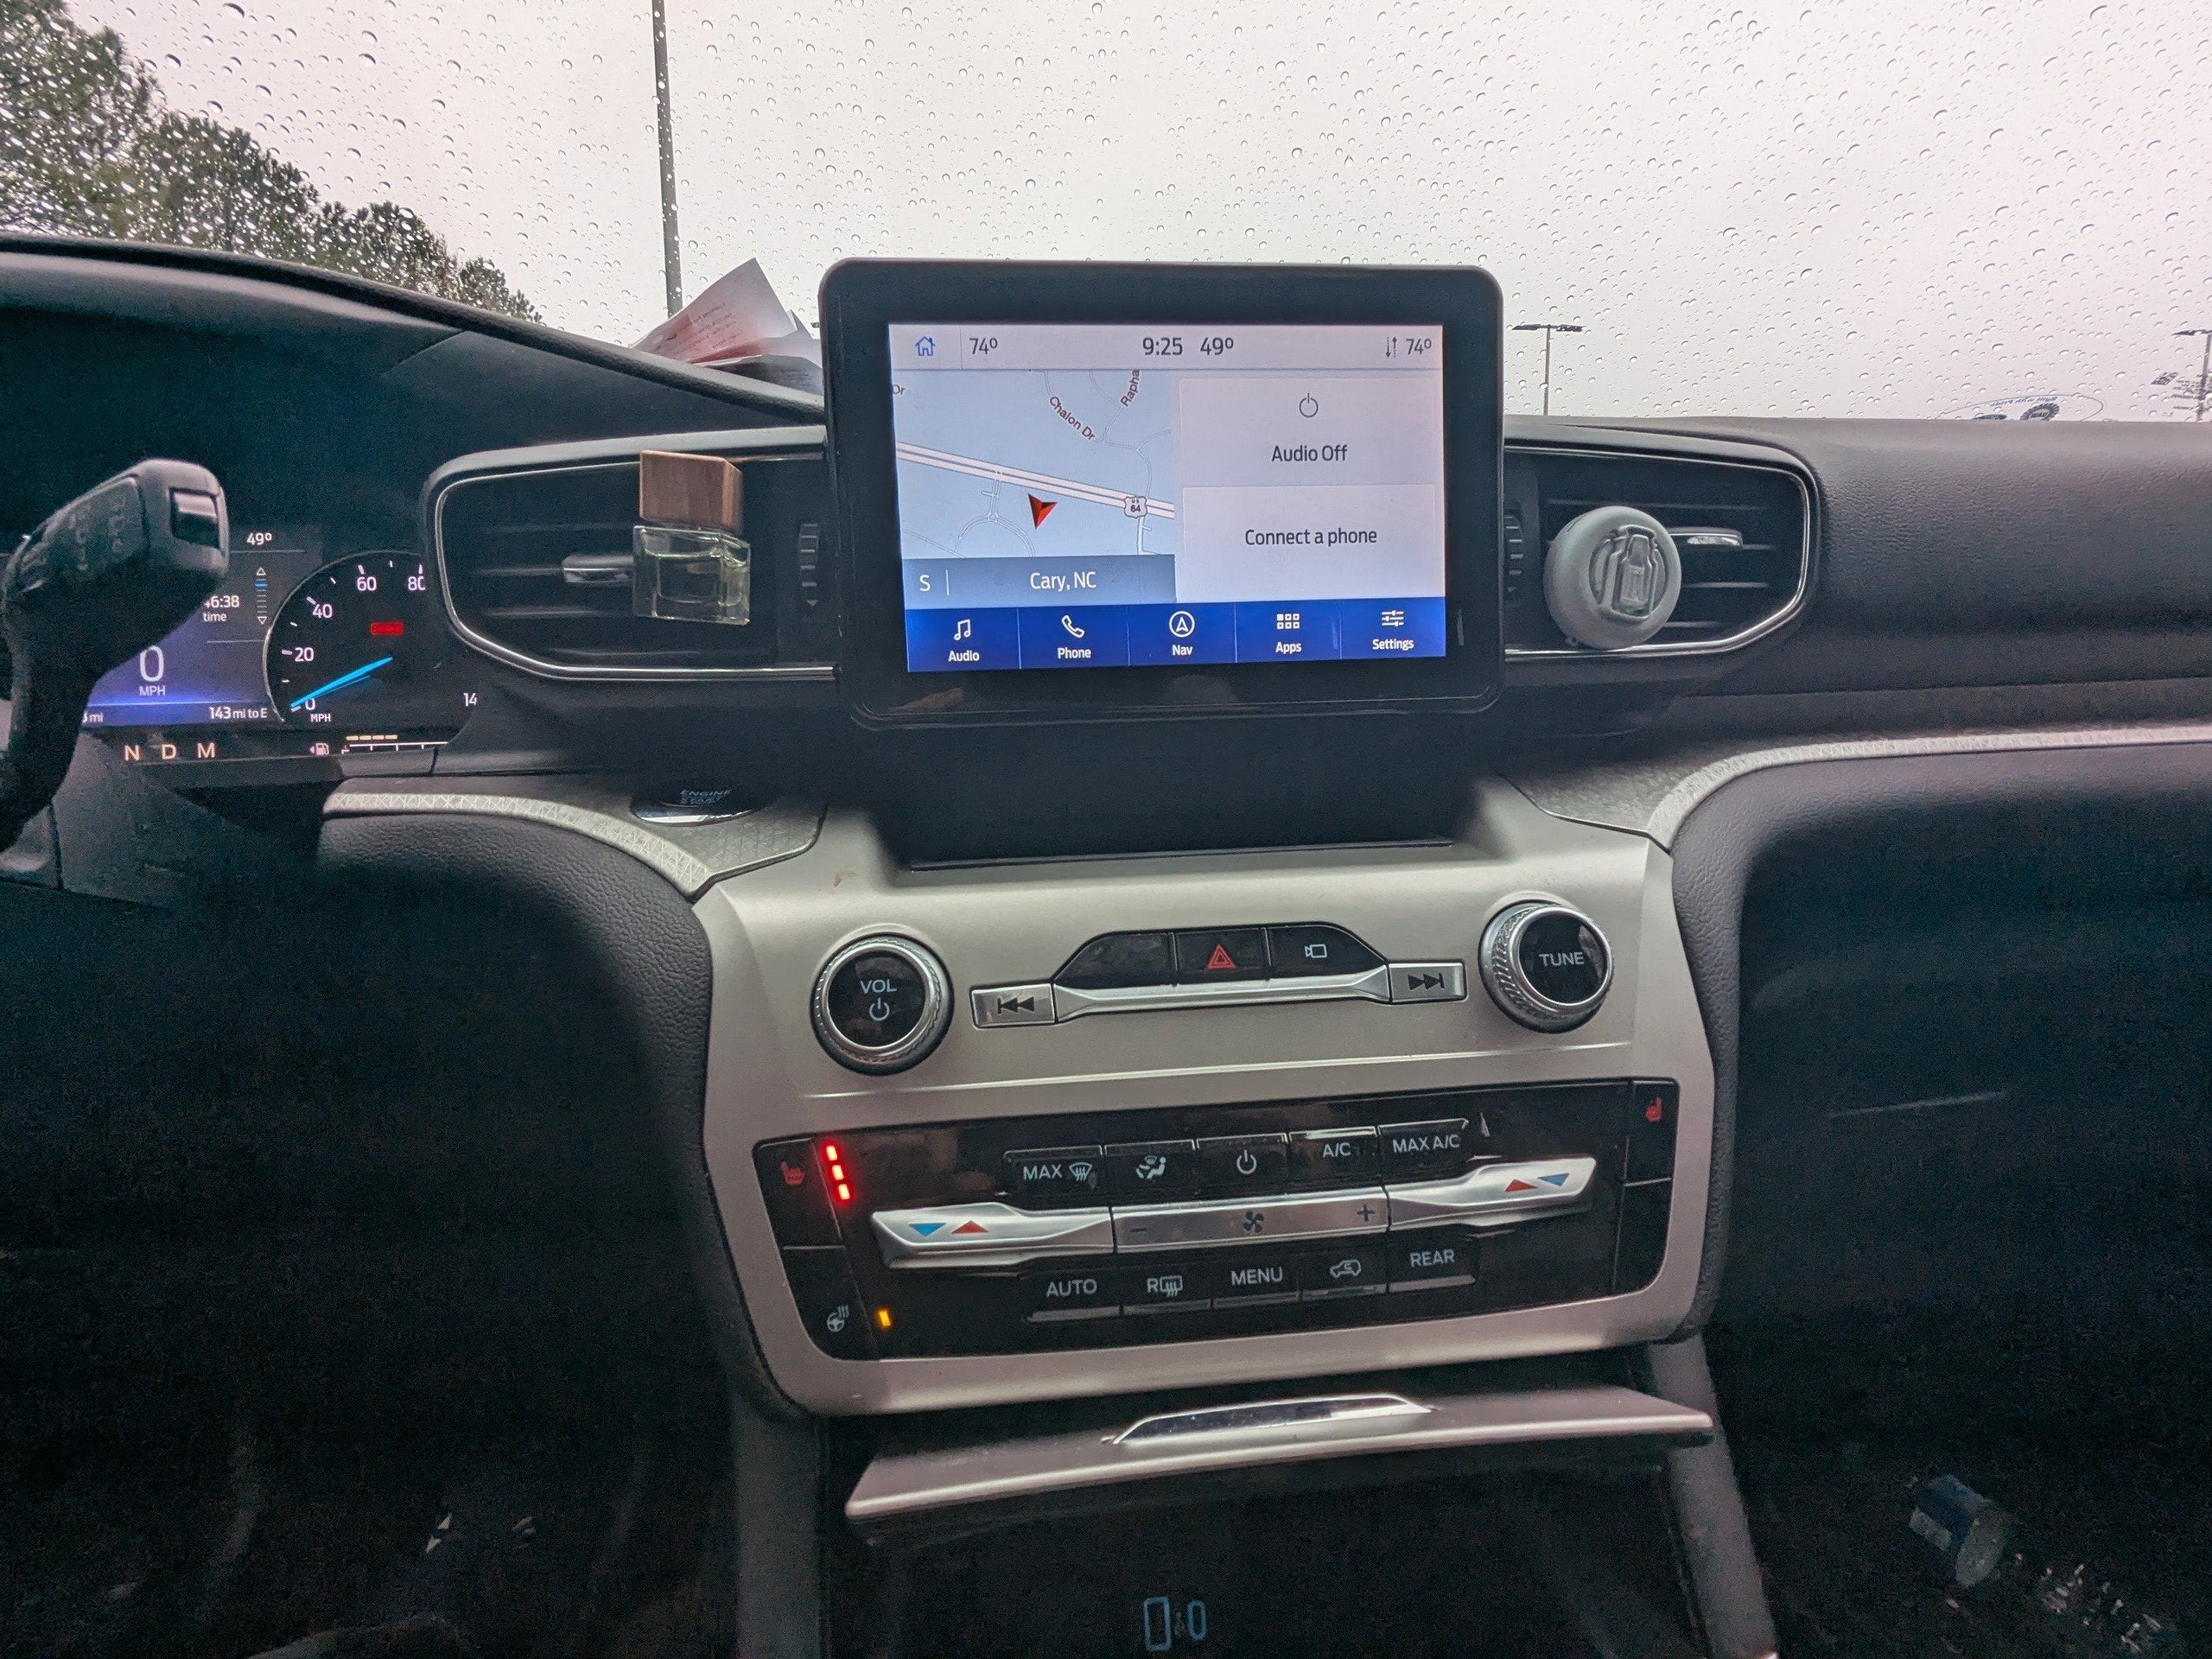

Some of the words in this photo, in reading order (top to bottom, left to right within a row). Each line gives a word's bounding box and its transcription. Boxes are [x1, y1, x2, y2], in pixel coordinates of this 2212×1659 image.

[1142, 337, 1184, 356] 9:25
[1050, 397, 1081, 430] Chalon
[1082, 427, 1096, 441] Dr
[1271, 445, 1318, 462] Audio
[1322, 444, 1348, 461] Off
[1245, 530, 1310, 545] Connect
[1314, 533, 1324, 543] a
[1328, 529, 1377, 546] phone
[357, 576, 377, 591] 60
[918, 575, 931, 592] S
[1030, 571, 1070, 591] Cary,
[1074, 571, 1096, 588] NC
[202, 612, 226, 622] time
[313, 604, 333, 619] 40
[1058, 646, 1091, 659] Phone
[1173, 645, 1193, 657] Nav
[1275, 642, 1301, 654] Apps
[1372, 638, 1414, 652] Settings
[295, 648, 314, 662] 20
[948, 650, 980, 662] Audio
[139, 645, 164, 682] 0
[139, 686, 166, 696] MPH
[305, 698, 316, 710] 0
[209, 707, 232, 719] 143
[232, 709, 246, 719] mi
[248, 708, 259, 718] to
[261, 708, 267, 718] E
[310, 714, 331, 722] MPH
[124, 744, 140, 761] N
[162, 744, 177, 760] D
[197, 742, 215, 758] M
[1539, 951, 1584, 967] TUNE
[860, 979, 897, 994] VOL
[1322, 1141, 1351, 1158] A/C
[1393, 1137, 1429, 1154] MAX
[1433, 1135, 1460, 1149] A/C
[1023, 1164, 1062, 1180] MAX
[1410, 1249, 1455, 1268] REAR
[1230, 1267, 1283, 1286] MENU
[1046, 1279, 1097, 1297] AUTO
